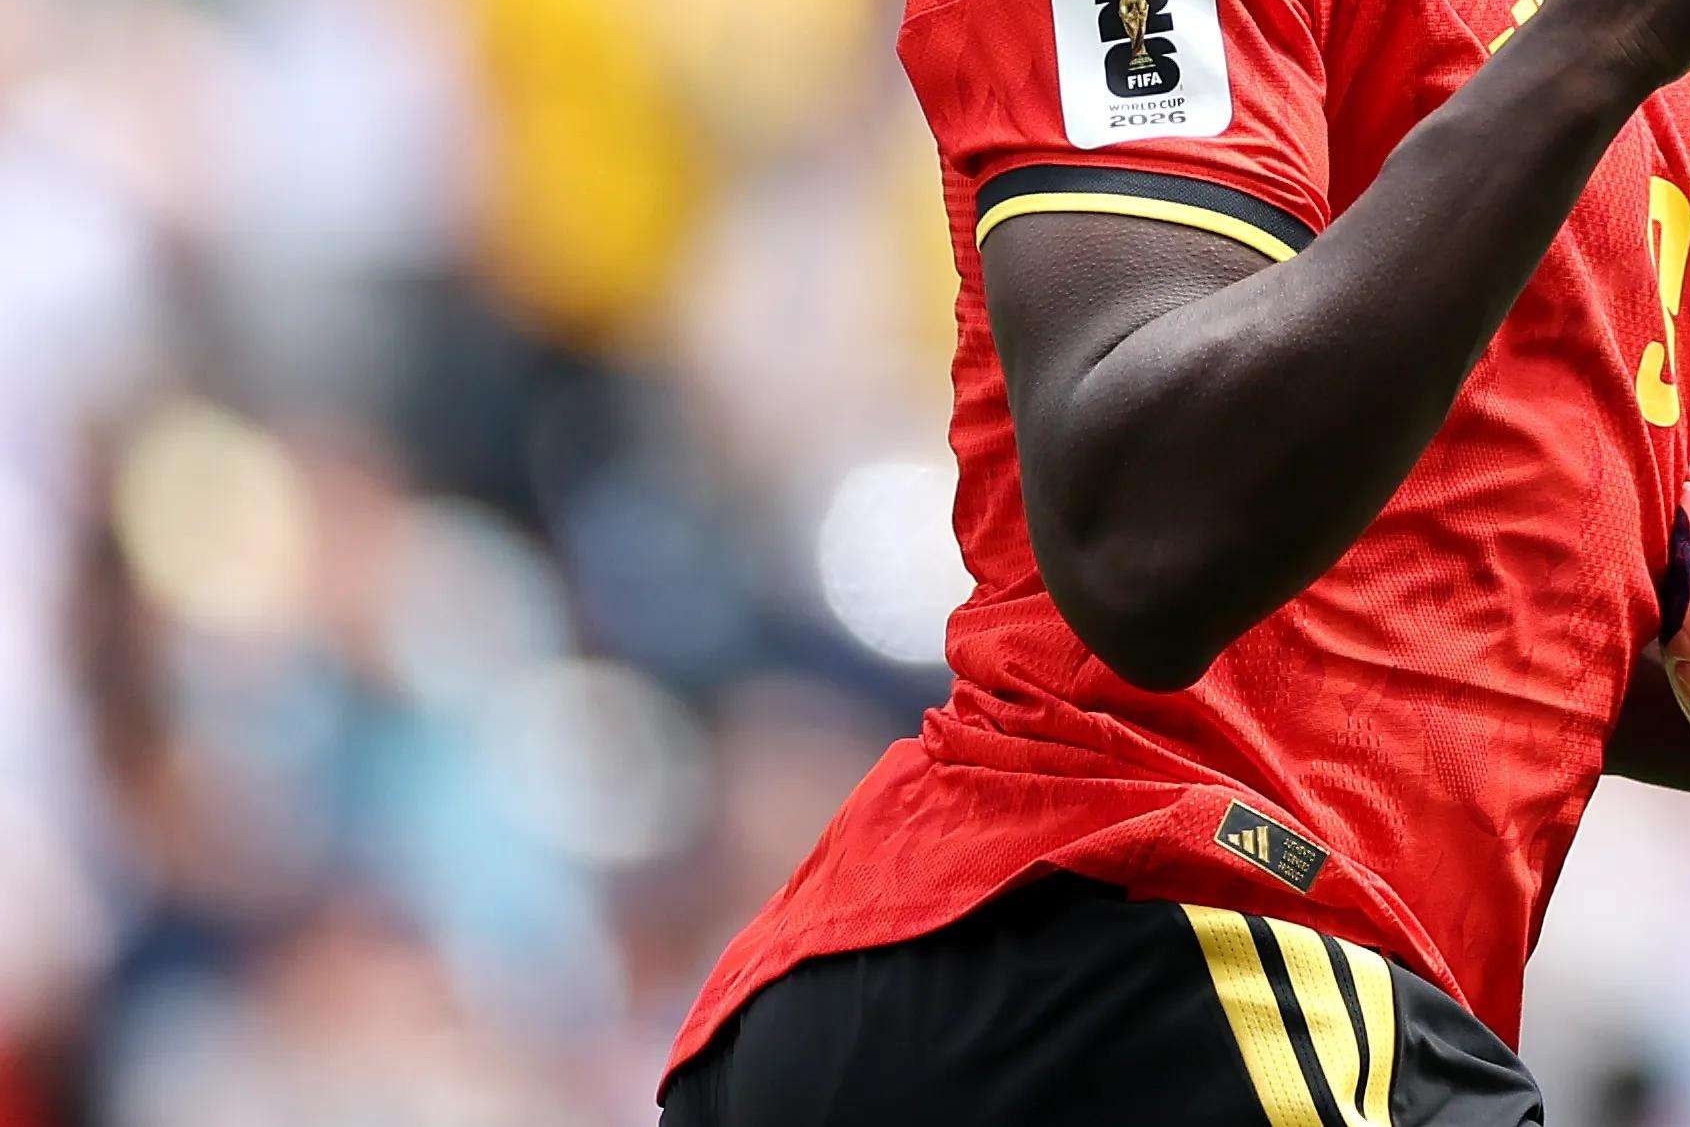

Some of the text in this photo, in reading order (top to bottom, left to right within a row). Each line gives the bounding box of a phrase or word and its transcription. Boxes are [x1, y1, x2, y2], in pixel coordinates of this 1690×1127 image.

[1127, 71, 1163, 90] FIFA
[1109, 97, 1186, 112] WORLD CUP
[1110, 110, 1187, 129] 2026
